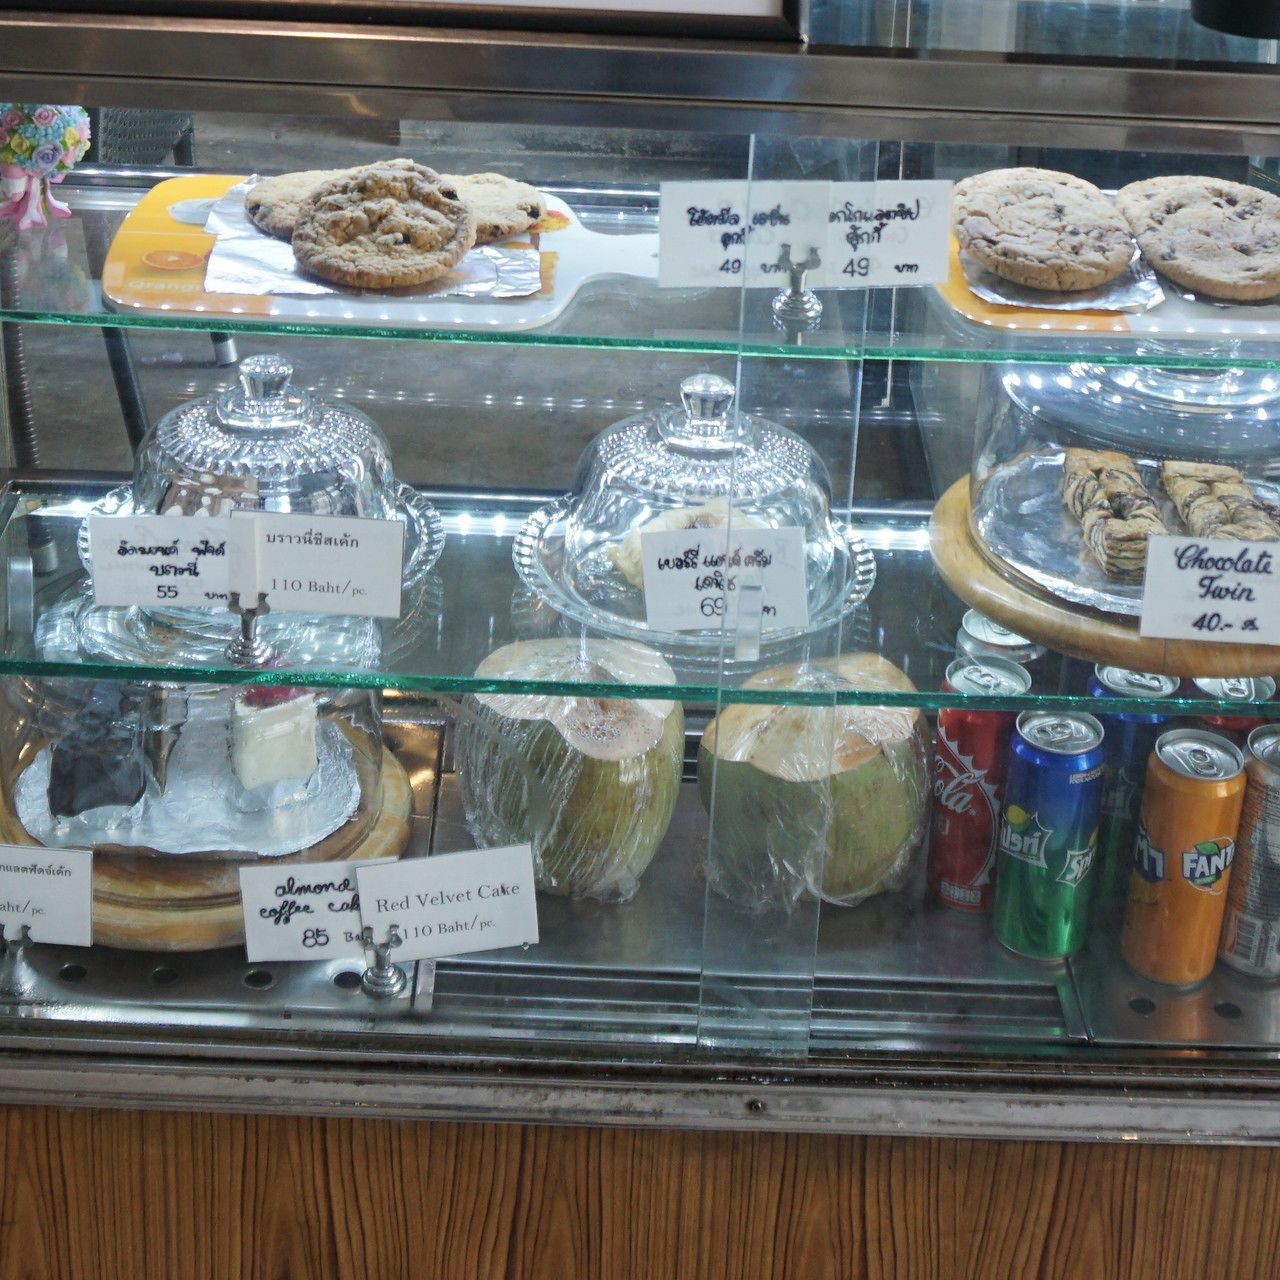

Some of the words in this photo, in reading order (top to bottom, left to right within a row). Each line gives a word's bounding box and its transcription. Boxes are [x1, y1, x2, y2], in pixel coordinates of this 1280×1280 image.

[719, 259, 742, 274] 49
[842, 257, 870, 277] 49
[1174, 544, 1274, 575] Chocolate
[157, 585, 179, 599] 55
[271, 578, 303, 592] 110
[1198, 575, 1256, 602] Twin
[700, 597, 728, 617] 69
[1182, 846, 1237, 878] FANT
[274, 876, 356, 898] almond
[260, 901, 315, 925] coffee
[327, 893, 360, 913] cak
[375, 896, 410, 914] Red
[418, 890, 472, 908] Velvet
[477, 883, 521, 900] Cake
[301, 927, 330, 948] 85
[402, 925, 433, 941] 110
